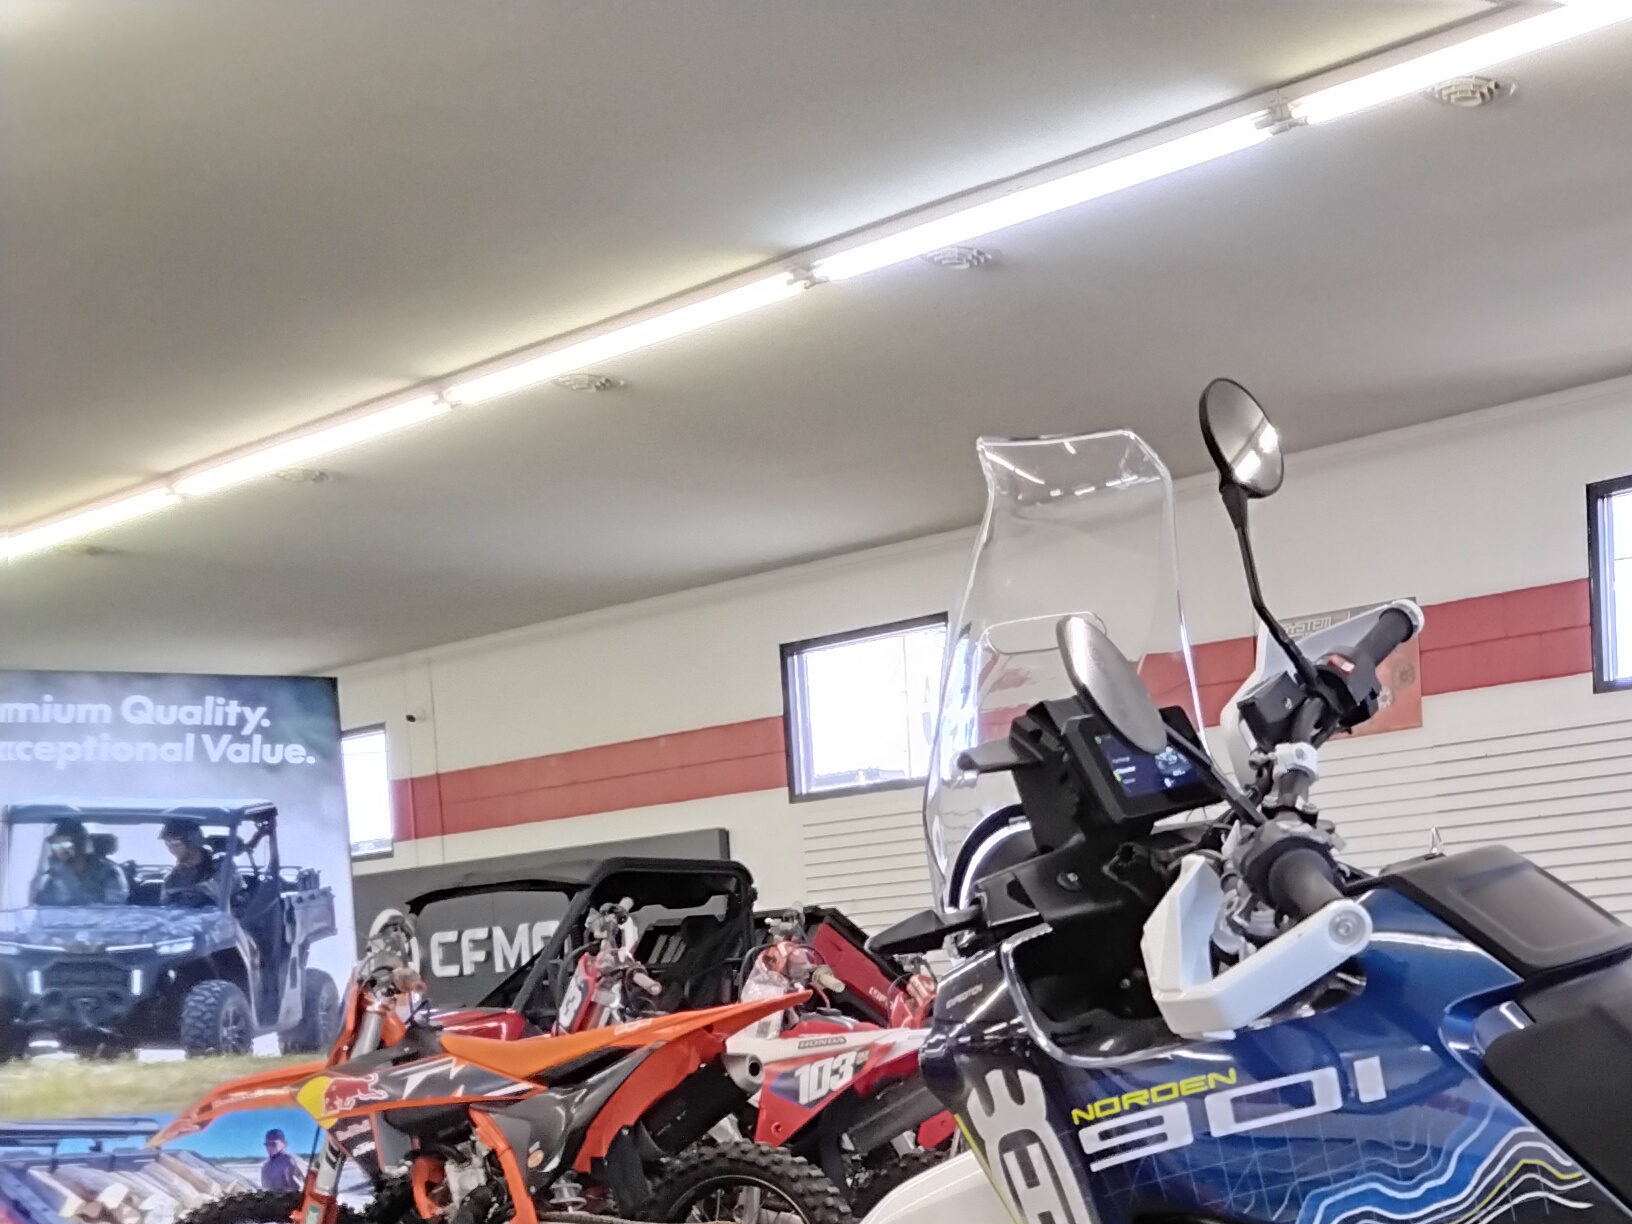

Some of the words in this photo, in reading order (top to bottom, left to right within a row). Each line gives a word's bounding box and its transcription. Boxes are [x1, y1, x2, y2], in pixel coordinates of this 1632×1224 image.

[121, 695, 271, 735] Quality.
[201, 734, 316, 764] Value.
[799, 1036, 847, 1049] HONDA
[794, 1051, 857, 1105] 103
[1071, 1067, 1238, 1125] NORDEN
[1078, 1056, 1387, 1173] 901
